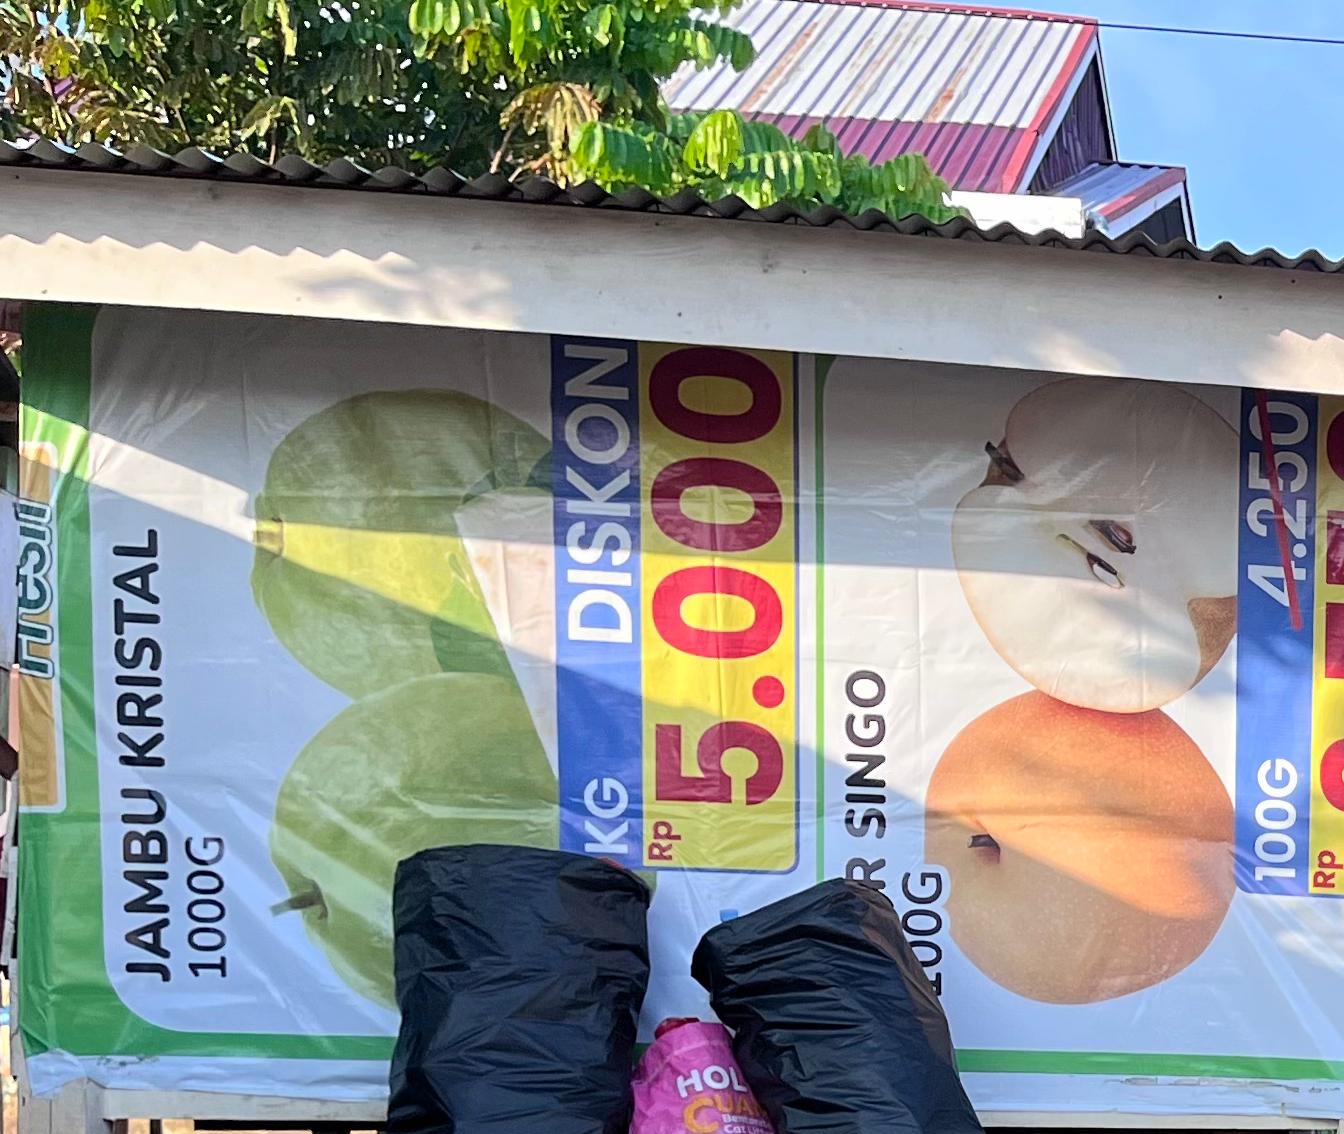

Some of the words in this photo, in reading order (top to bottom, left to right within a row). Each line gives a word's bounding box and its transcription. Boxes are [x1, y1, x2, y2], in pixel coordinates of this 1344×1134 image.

[564, 344, 634, 644] DISKON
[1246, 400, 1311, 610] 4.250
[112, 527, 167, 768] KRISTAL
[648, 346, 785, 806] 5.000
[583, 776, 630, 854] KG
[844, 669, 887, 839] SINGO
[1254, 757, 1299, 882] 100G
[122, 789, 170, 982] JAMBU
[186, 835, 227, 979] 1000G
[647, 821, 683, 862] Rp
[1312, 849, 1344, 889] Rp
[676, 1064, 748, 1098] HOL
